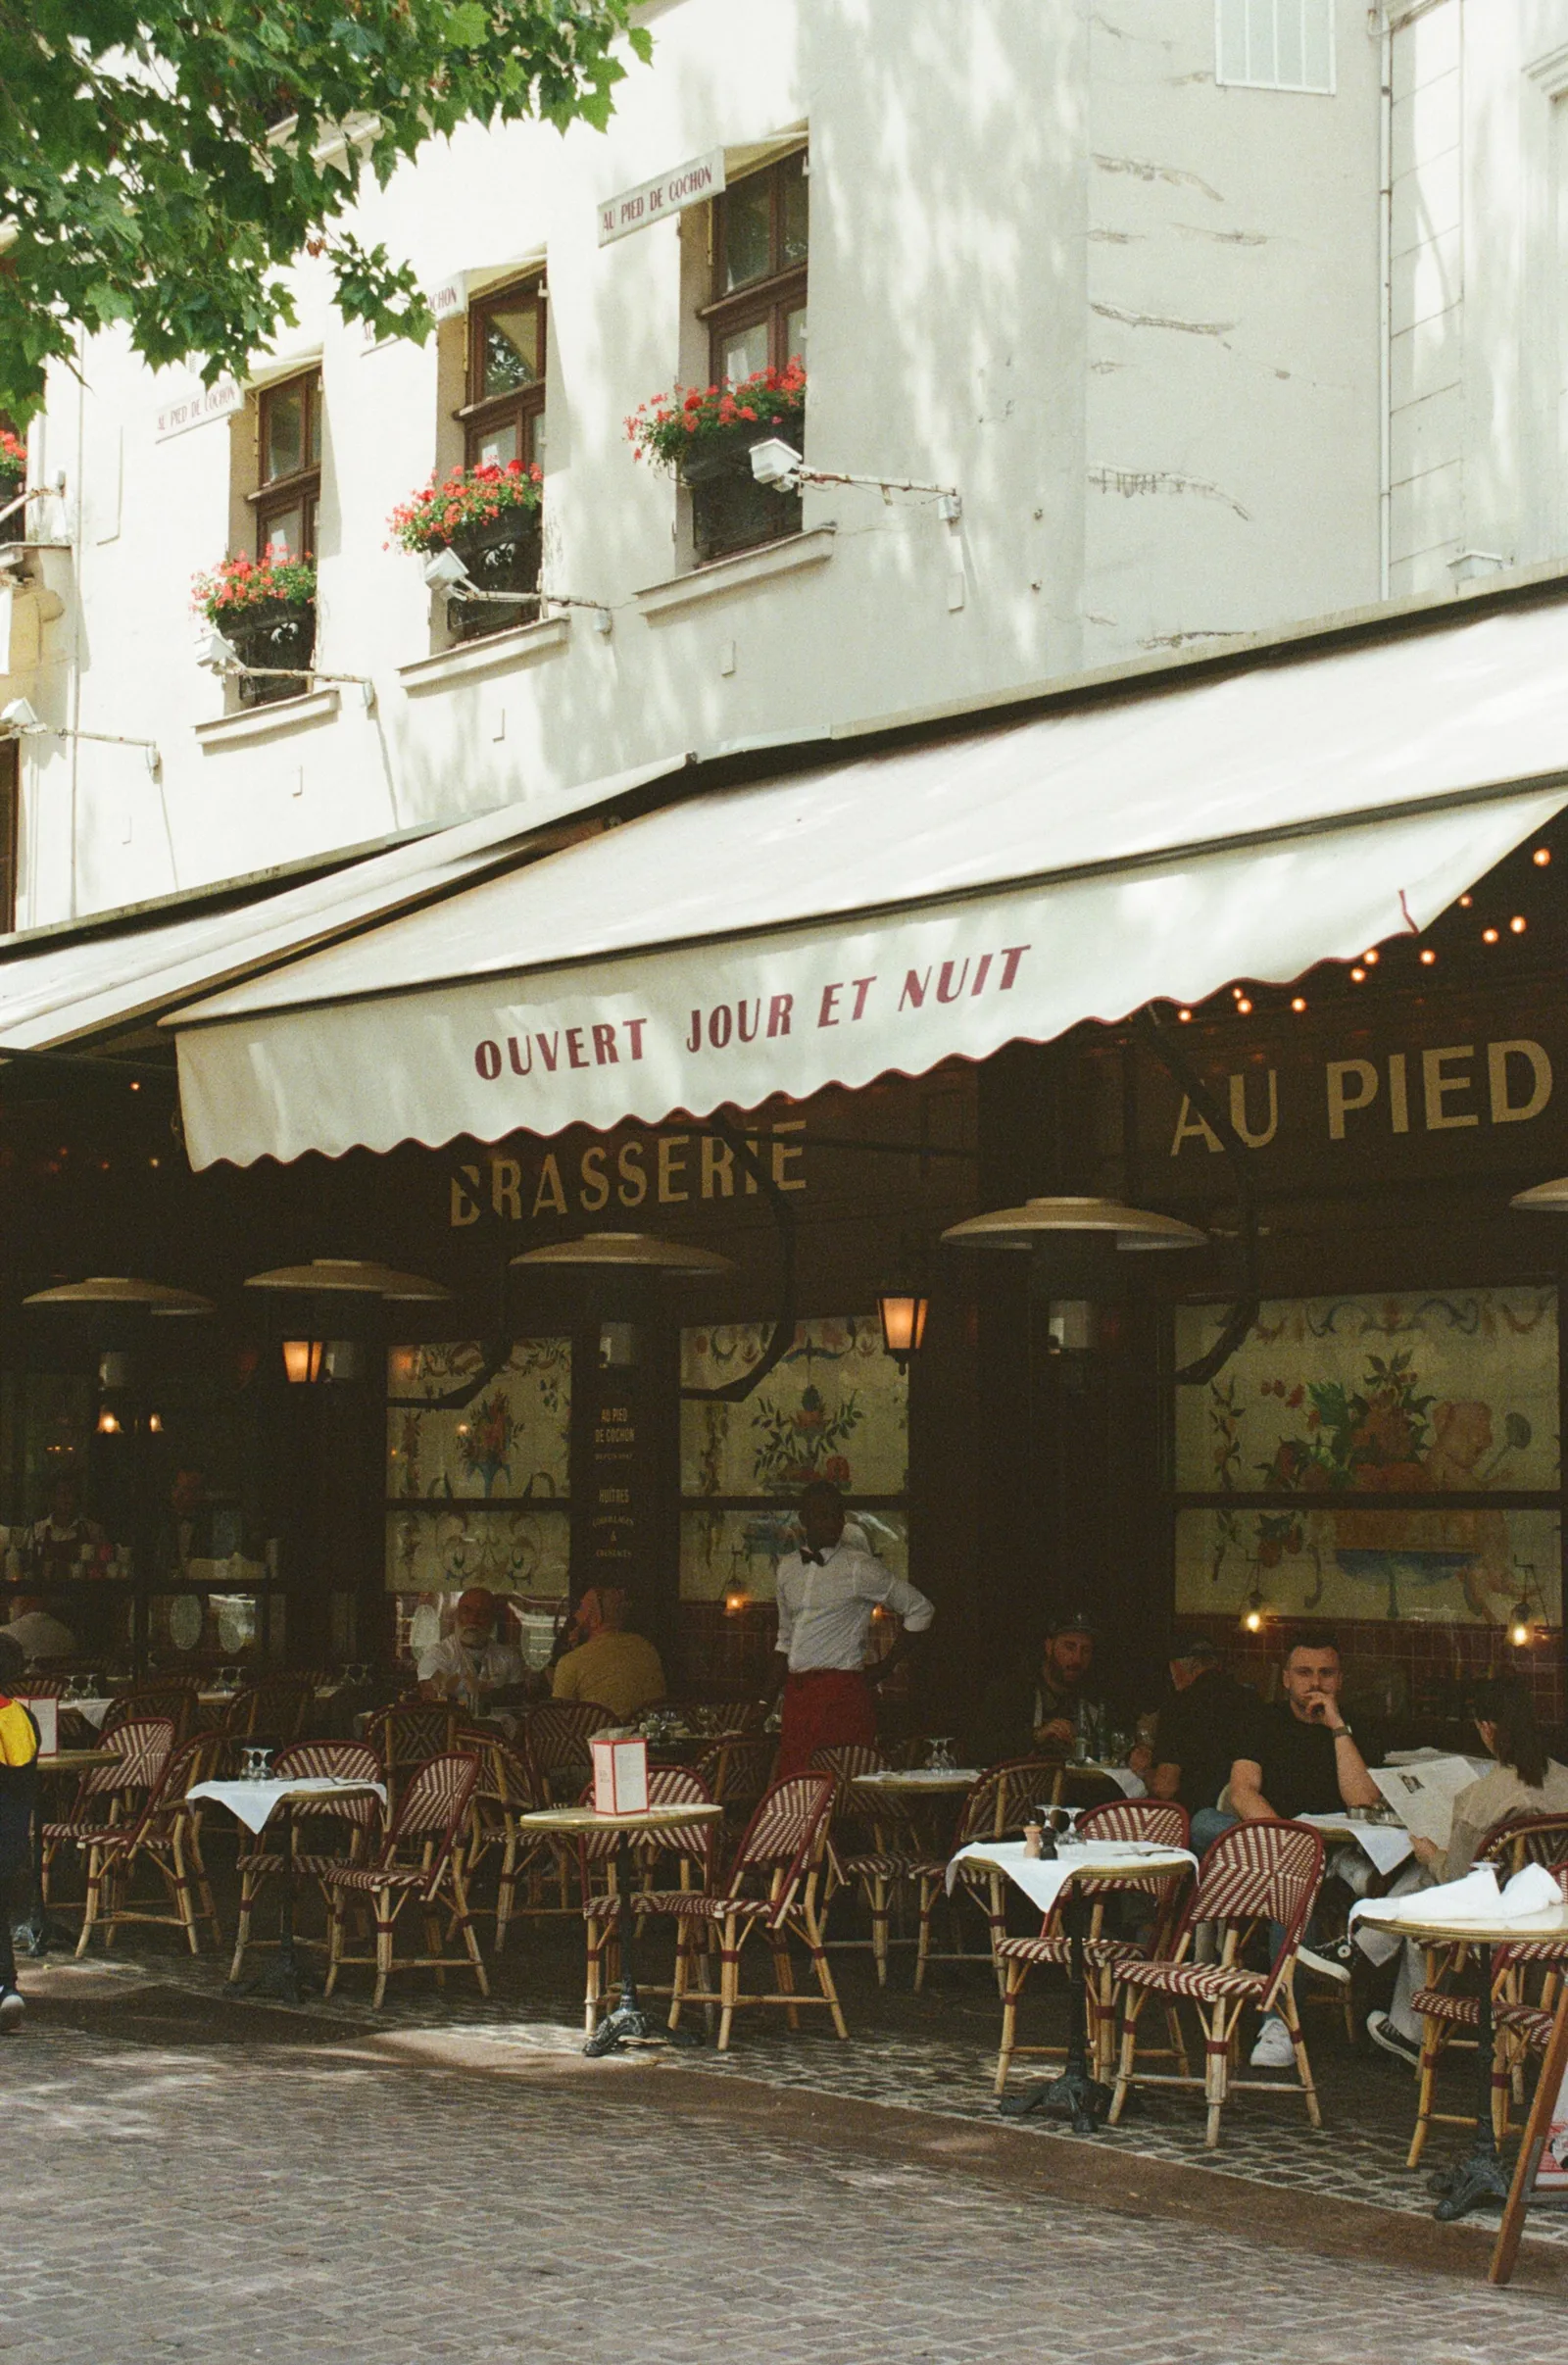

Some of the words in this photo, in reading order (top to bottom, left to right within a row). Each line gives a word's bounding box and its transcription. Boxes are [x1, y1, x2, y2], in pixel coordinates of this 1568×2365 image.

[603, 207, 615, 230] AU
[620, 196, 645, 224] PIED
[649, 186, 664, 212] DE
[668, 163, 712, 201] COCHON
[171, 405, 188, 427] PIED
[191, 398, 201, 419] DE
[474, 1017, 648, 1080] OUVERT
[686, 993, 794, 1054] JOUR
[817, 975, 878, 1028] ET
[897, 944, 1032, 1012] NUIT
[1170, 1069, 1278, 1158] AU
[1326, 1039, 1553, 1141] PIED
[595, 1429, 604, 1442] DE
[606, 1427, 635, 1443] COCHON
[612, 1407, 628, 1422] PIED
